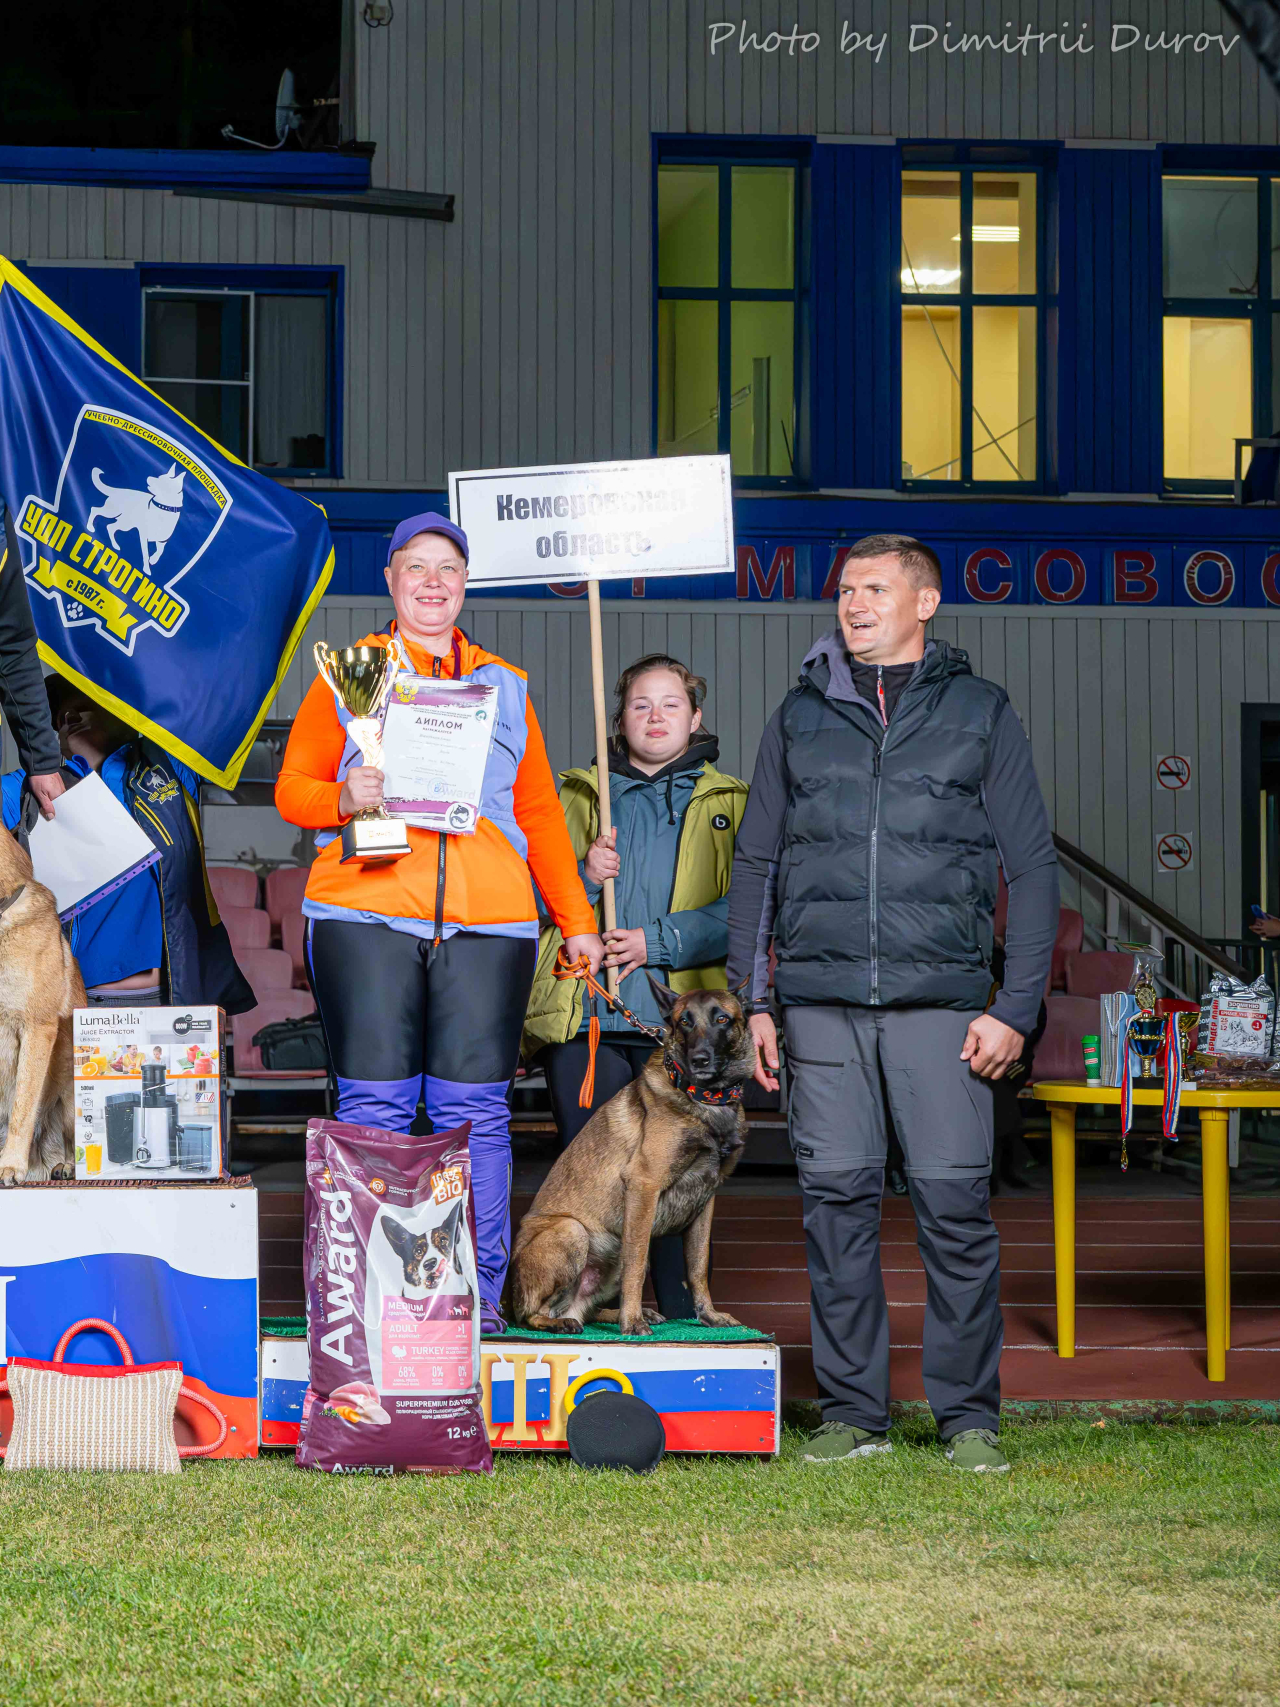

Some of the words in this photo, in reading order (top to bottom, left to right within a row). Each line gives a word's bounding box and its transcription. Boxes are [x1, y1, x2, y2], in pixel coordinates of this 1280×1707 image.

[87, 411, 192, 467] УЧЕБНО-ДРЕССИРОВОЧНАЯ
[190, 464, 227, 506] ПЛОЩАДКА
[22, 502, 73, 552] УДП
[69, 532, 183, 629] СТРОГИНО
[73, 580, 100, 604] 1987
[415, 716, 463, 730] ДИПЛОМ
[438, 1182, 461, 1202] BIO
[320, 1190, 357, 1367] Award
[388, 1301, 424, 1312] MEDIUM
[389, 1324, 419, 1333] ADULT
[411, 1346, 445, 1355] TURKEY
[398, 1365, 416, 1377] 68%
[432, 1365, 444, 1377] 0%
[447, 1427, 460, 1439] 12
[462, 1430, 470, 1438] kg
